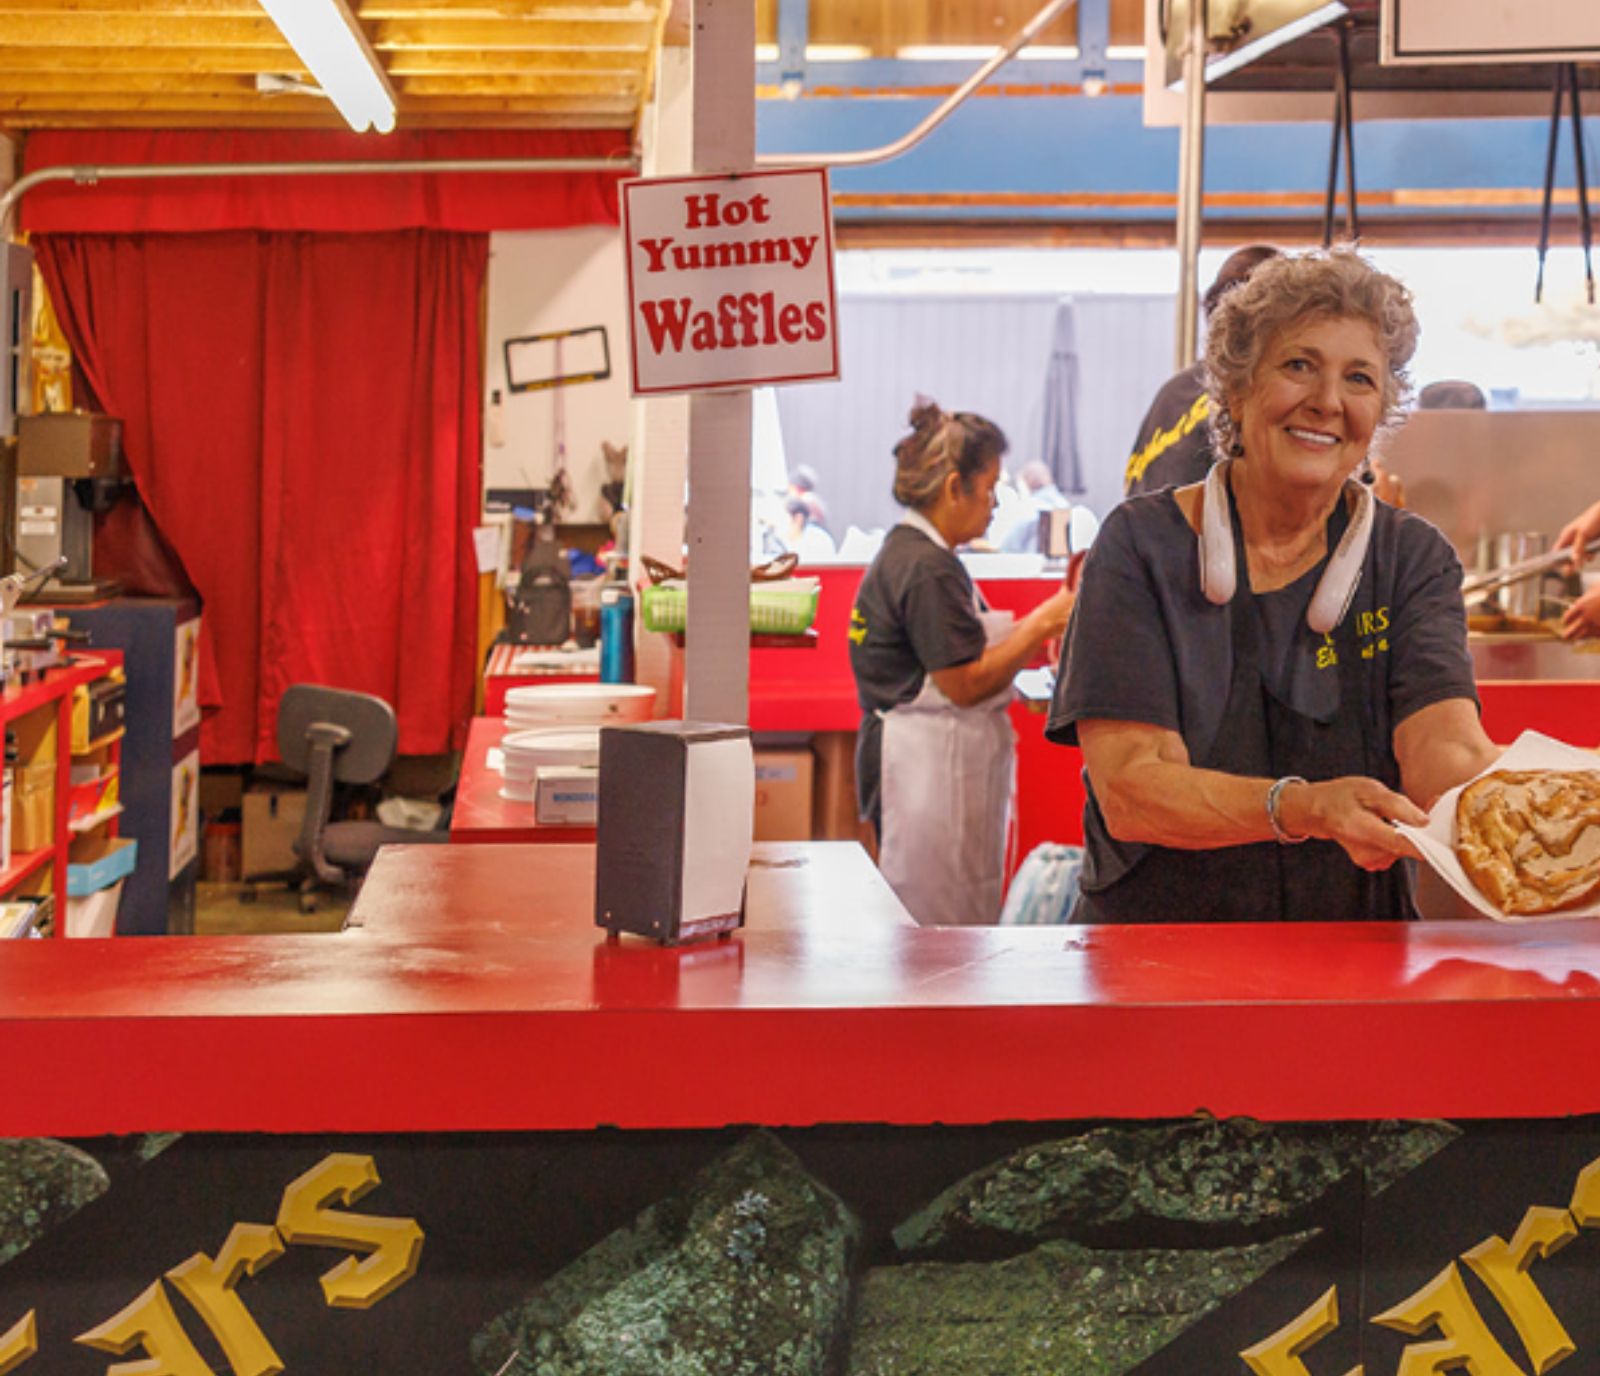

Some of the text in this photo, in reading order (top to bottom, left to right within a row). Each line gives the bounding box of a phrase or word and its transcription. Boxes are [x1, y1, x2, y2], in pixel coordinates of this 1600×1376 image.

[684, 193, 770, 229] Hot
[637, 235, 819, 272] Yummy
[639, 290, 826, 356] Waffles
[0, 1152, 425, 1376] ars
